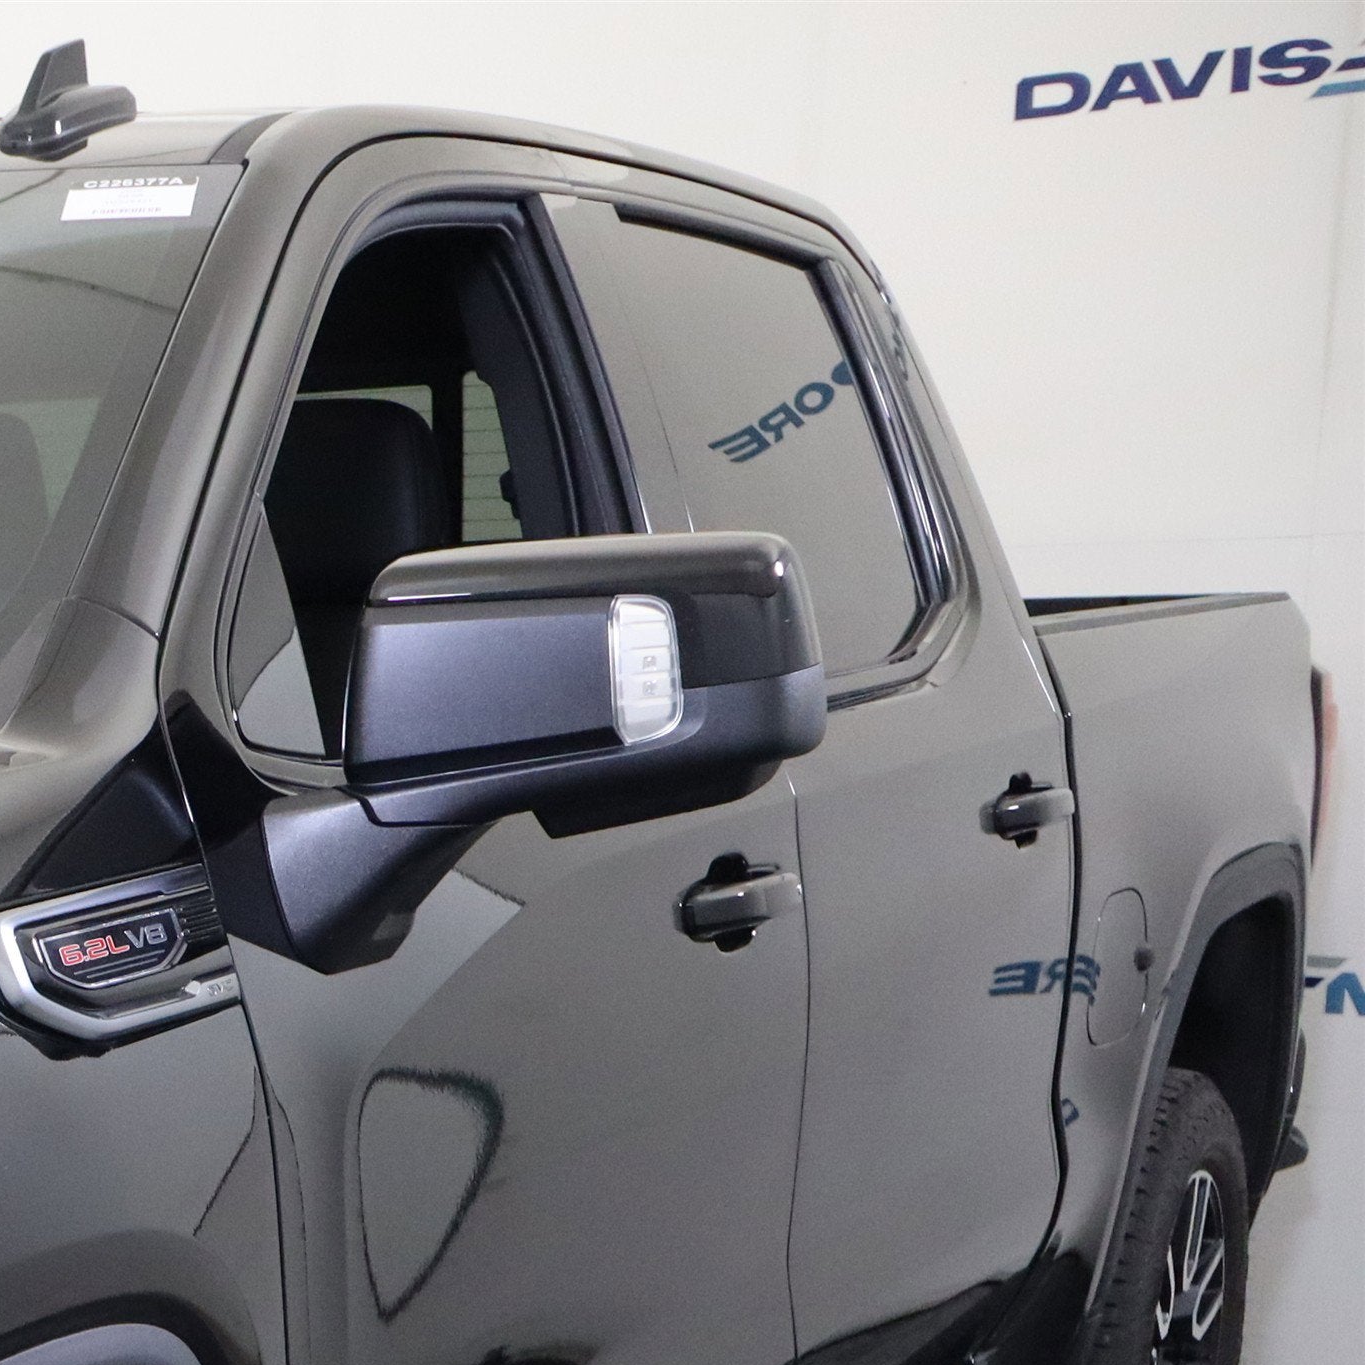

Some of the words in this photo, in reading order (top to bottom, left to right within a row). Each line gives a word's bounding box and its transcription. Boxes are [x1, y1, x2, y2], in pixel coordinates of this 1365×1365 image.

[1013, 37, 1333, 122] DAVIS
[58, 934, 131, 967] 6.2L
[124, 922, 169, 950] V8
